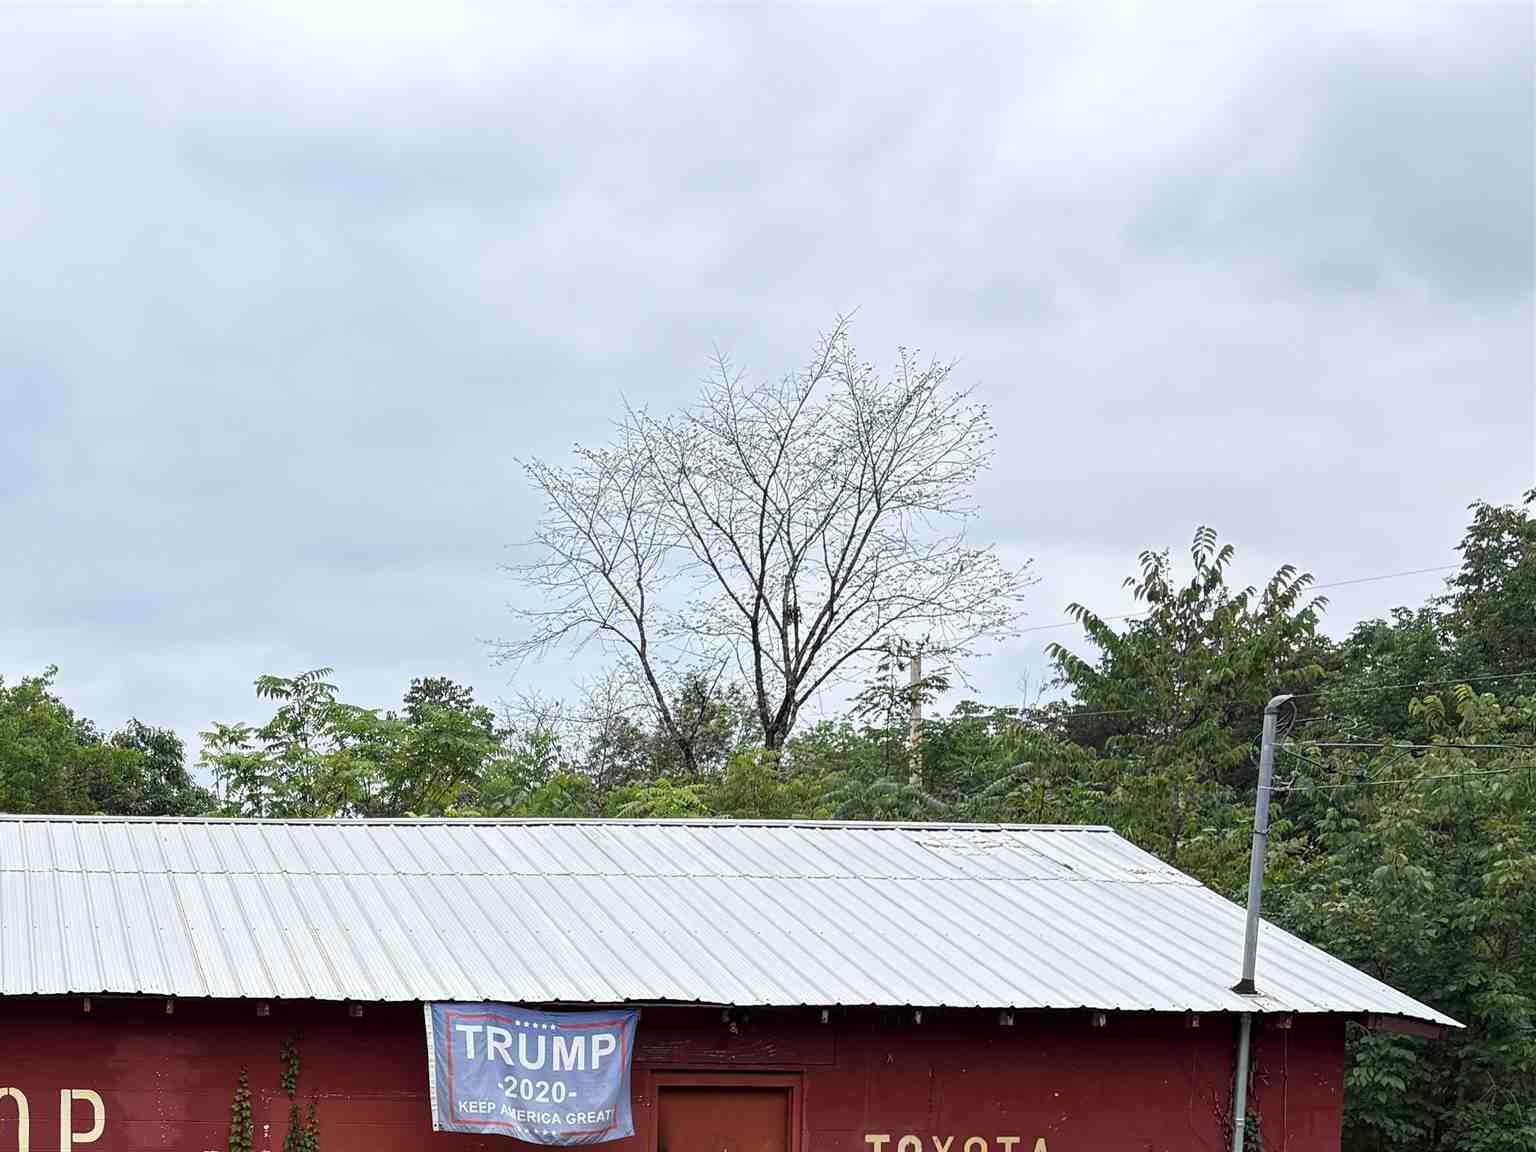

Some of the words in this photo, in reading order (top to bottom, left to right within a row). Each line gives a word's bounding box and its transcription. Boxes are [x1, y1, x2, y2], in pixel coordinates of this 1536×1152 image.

[455, 1024, 616, 1071] TRUMP
[459, 1101, 496, 1114] KEEP
[500, 1104, 561, 1124] AMERICA
